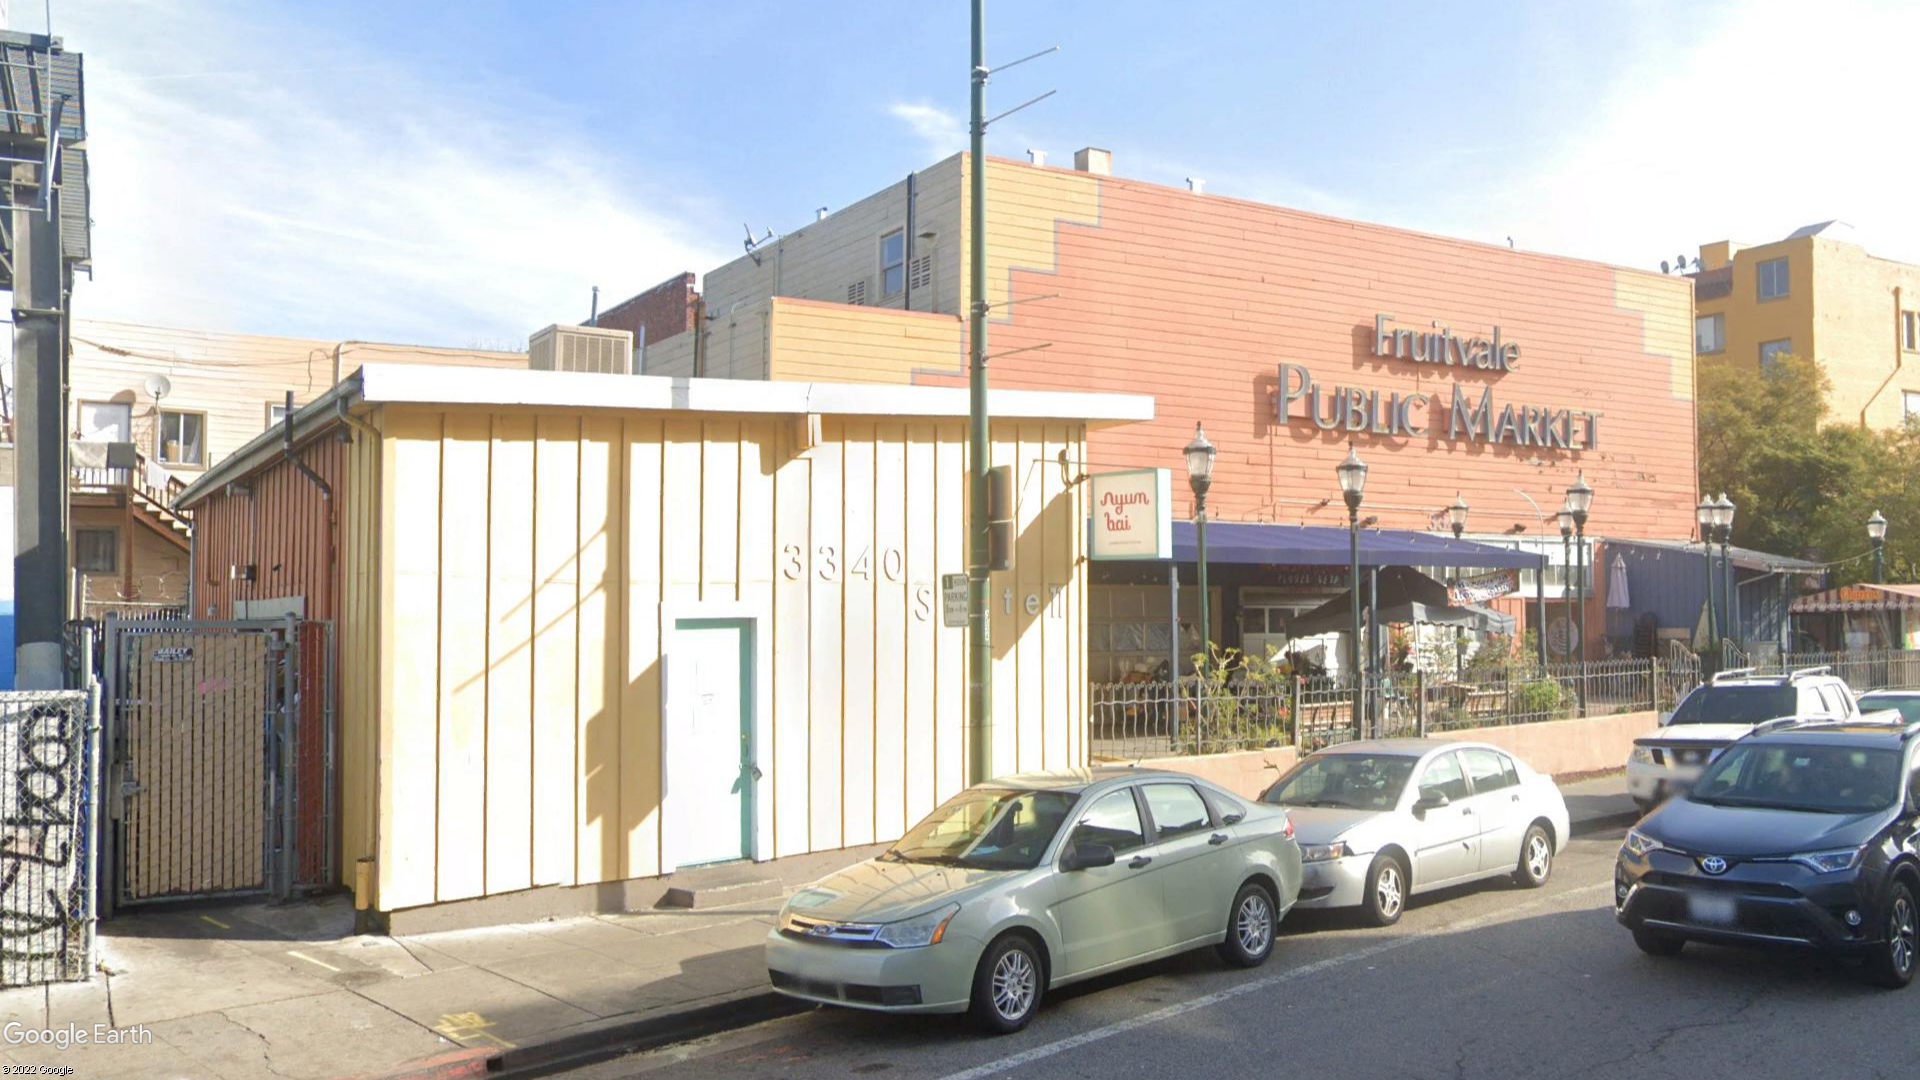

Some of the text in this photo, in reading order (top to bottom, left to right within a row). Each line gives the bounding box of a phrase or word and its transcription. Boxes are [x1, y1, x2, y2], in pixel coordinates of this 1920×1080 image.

[1373, 313, 1521, 373] Fruitvale
[1276, 362, 1604, 451] PUBLIC MARKET
[783, 544, 902, 581] 3340
[944, 591, 968, 603] PARKING
[953, 577, 967, 587] HOUR
